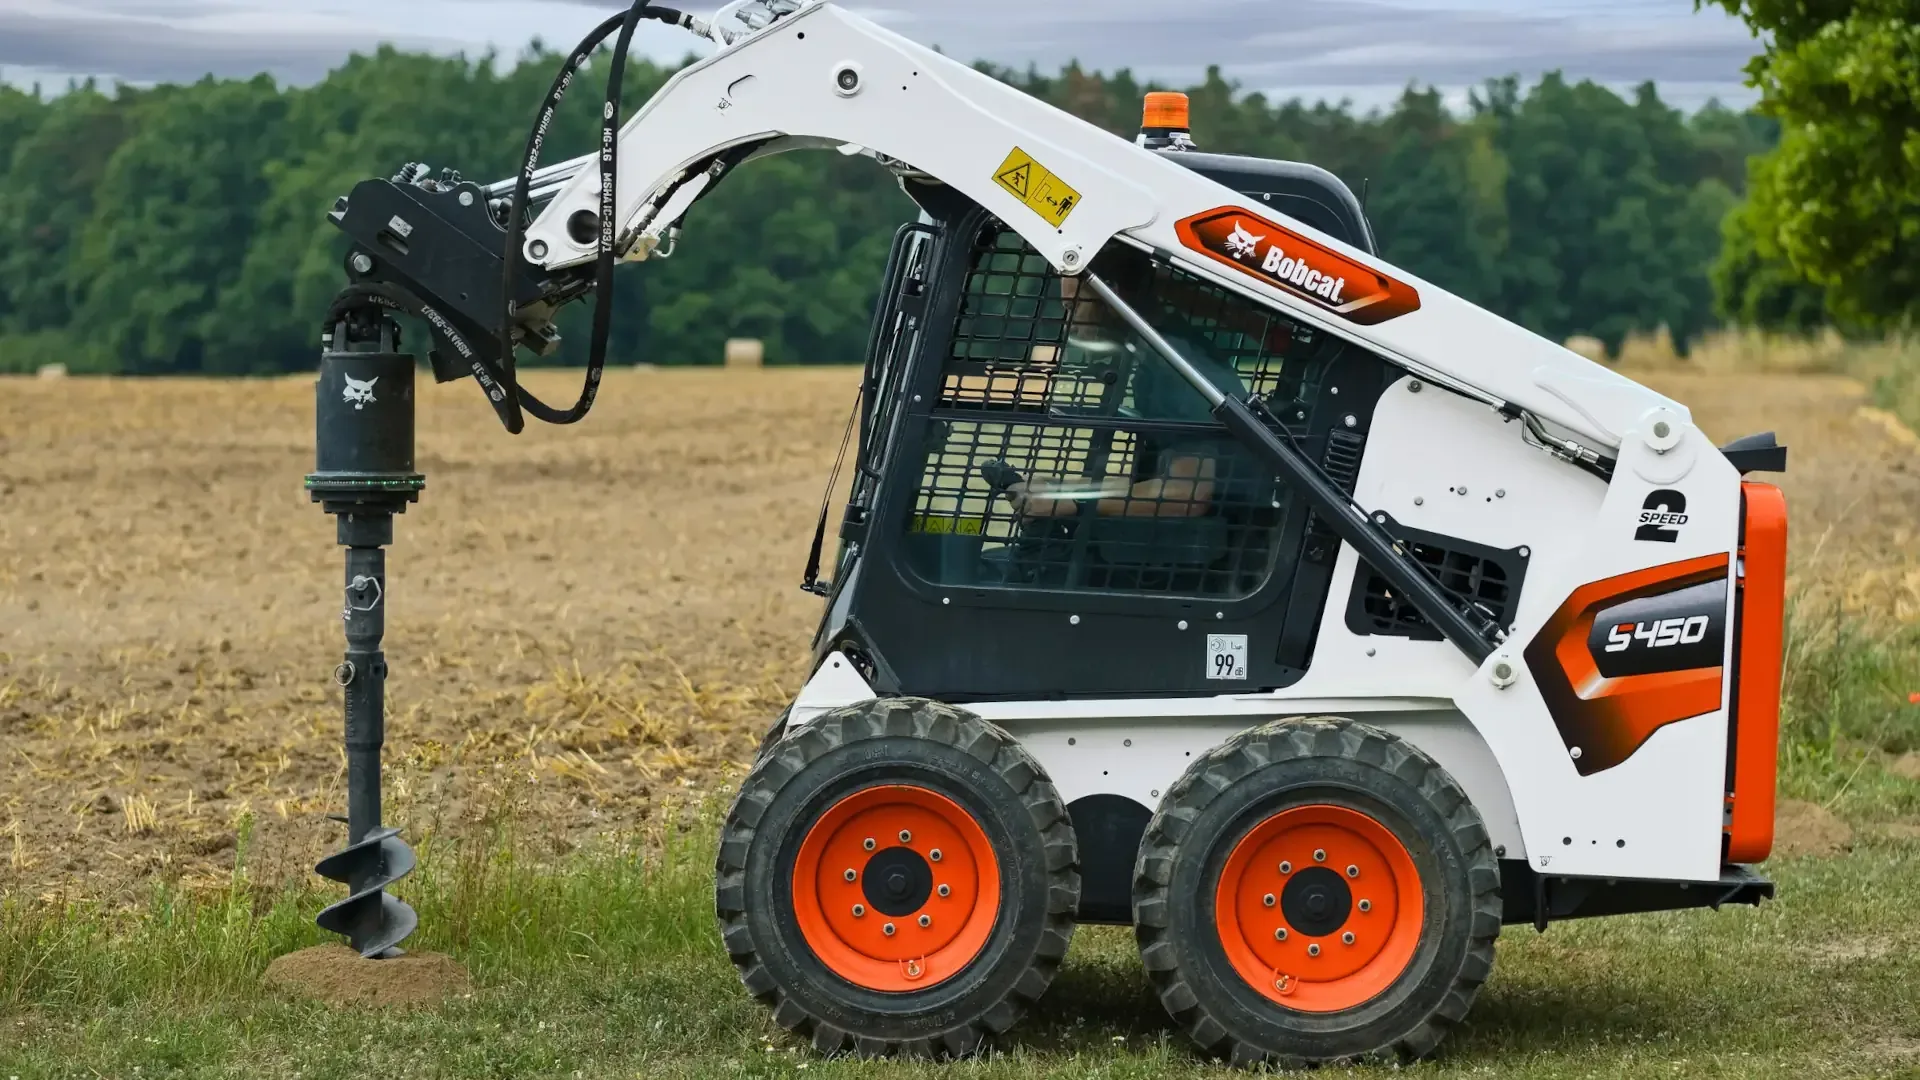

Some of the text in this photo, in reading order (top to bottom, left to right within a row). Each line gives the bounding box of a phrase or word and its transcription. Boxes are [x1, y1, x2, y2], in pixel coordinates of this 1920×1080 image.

[553, 71, 573, 100] HG-16
[602, 127, 612, 162] HG-16
[602, 172, 612, 202] MSHA
[1261, 244, 1345, 303] Bobcat
[1634, 489, 1689, 543] 2 SPEED
[1604, 615, 1709, 653] S450
[1215, 653, 1235, 676] 99
